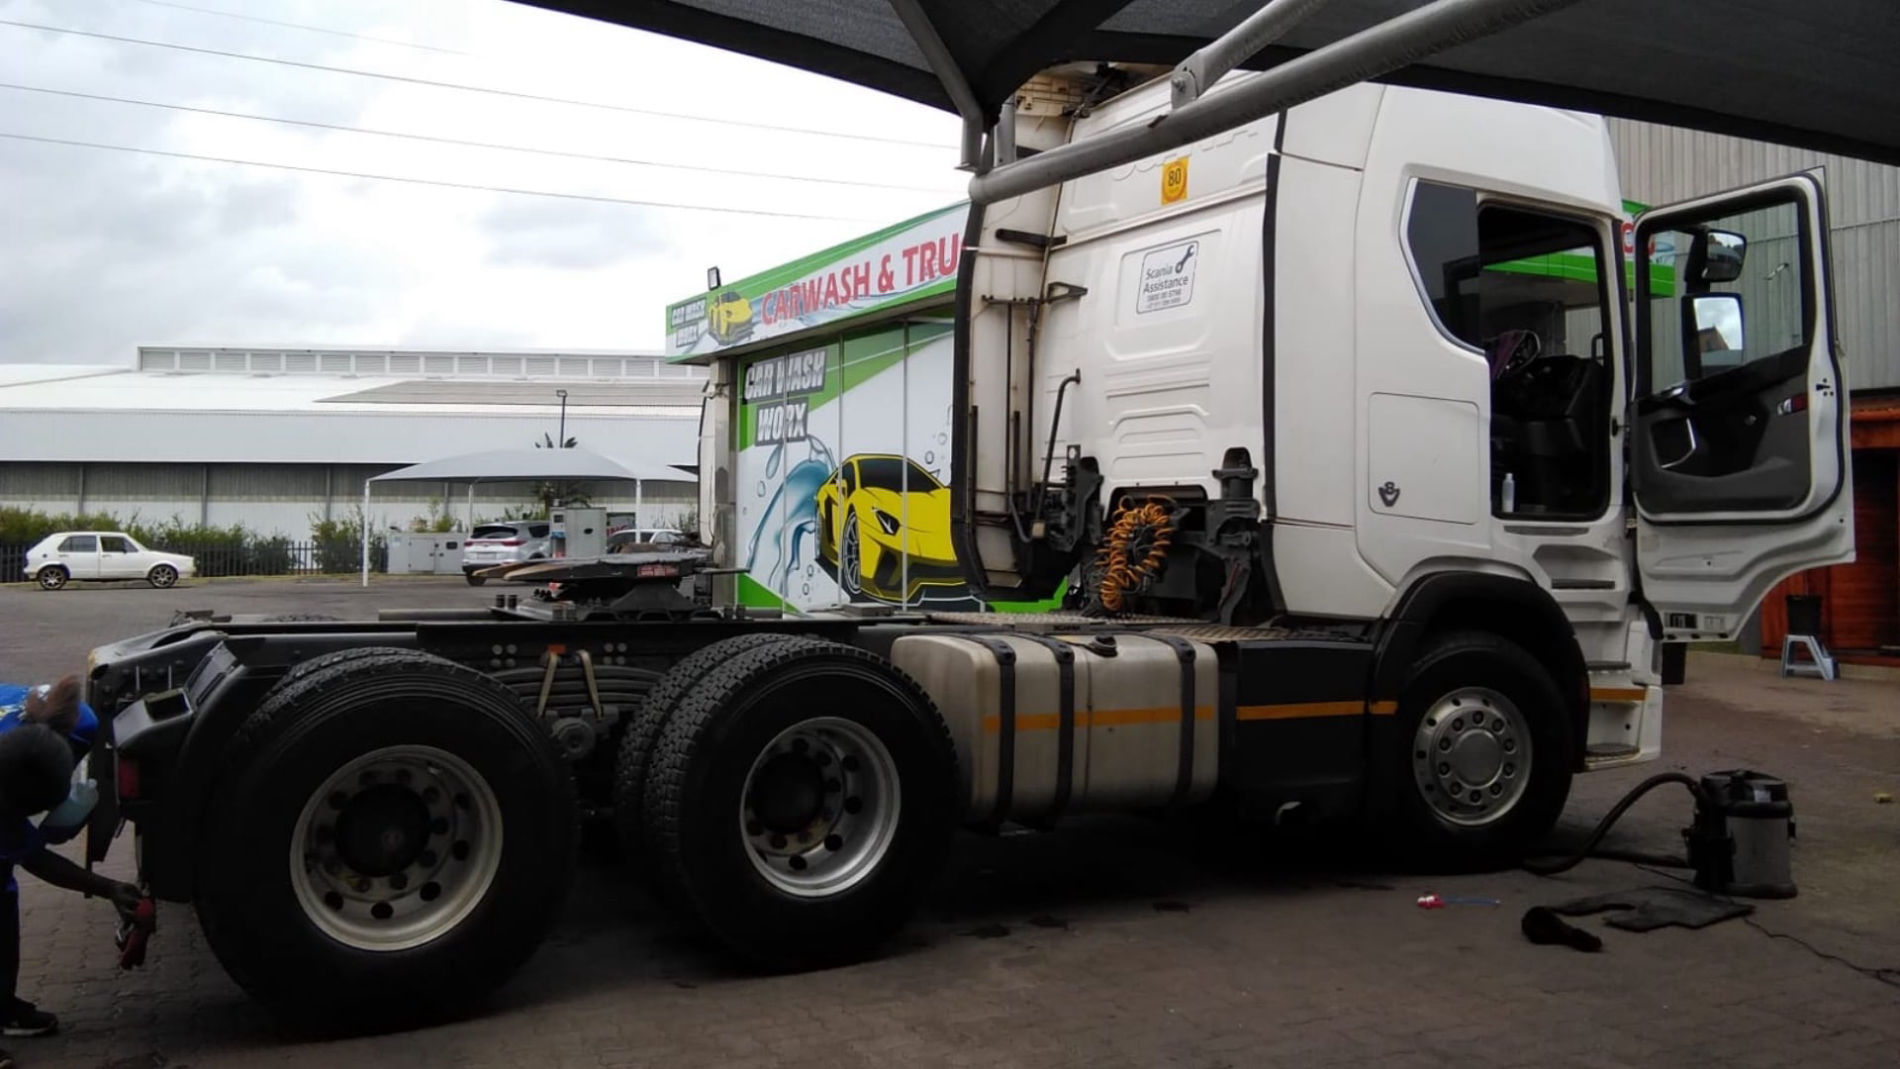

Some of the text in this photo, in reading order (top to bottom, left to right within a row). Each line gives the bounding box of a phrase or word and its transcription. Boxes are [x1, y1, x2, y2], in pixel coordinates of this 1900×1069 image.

[1168, 168, 1181, 186] 80
[761, 233, 962, 325] CARWASH & TRU
[1143, 276, 1189, 294] Assistance
[1145, 266, 1173, 279] Scania
[744, 351, 826, 400] CAR WASH
[757, 403, 807, 442] WORX
